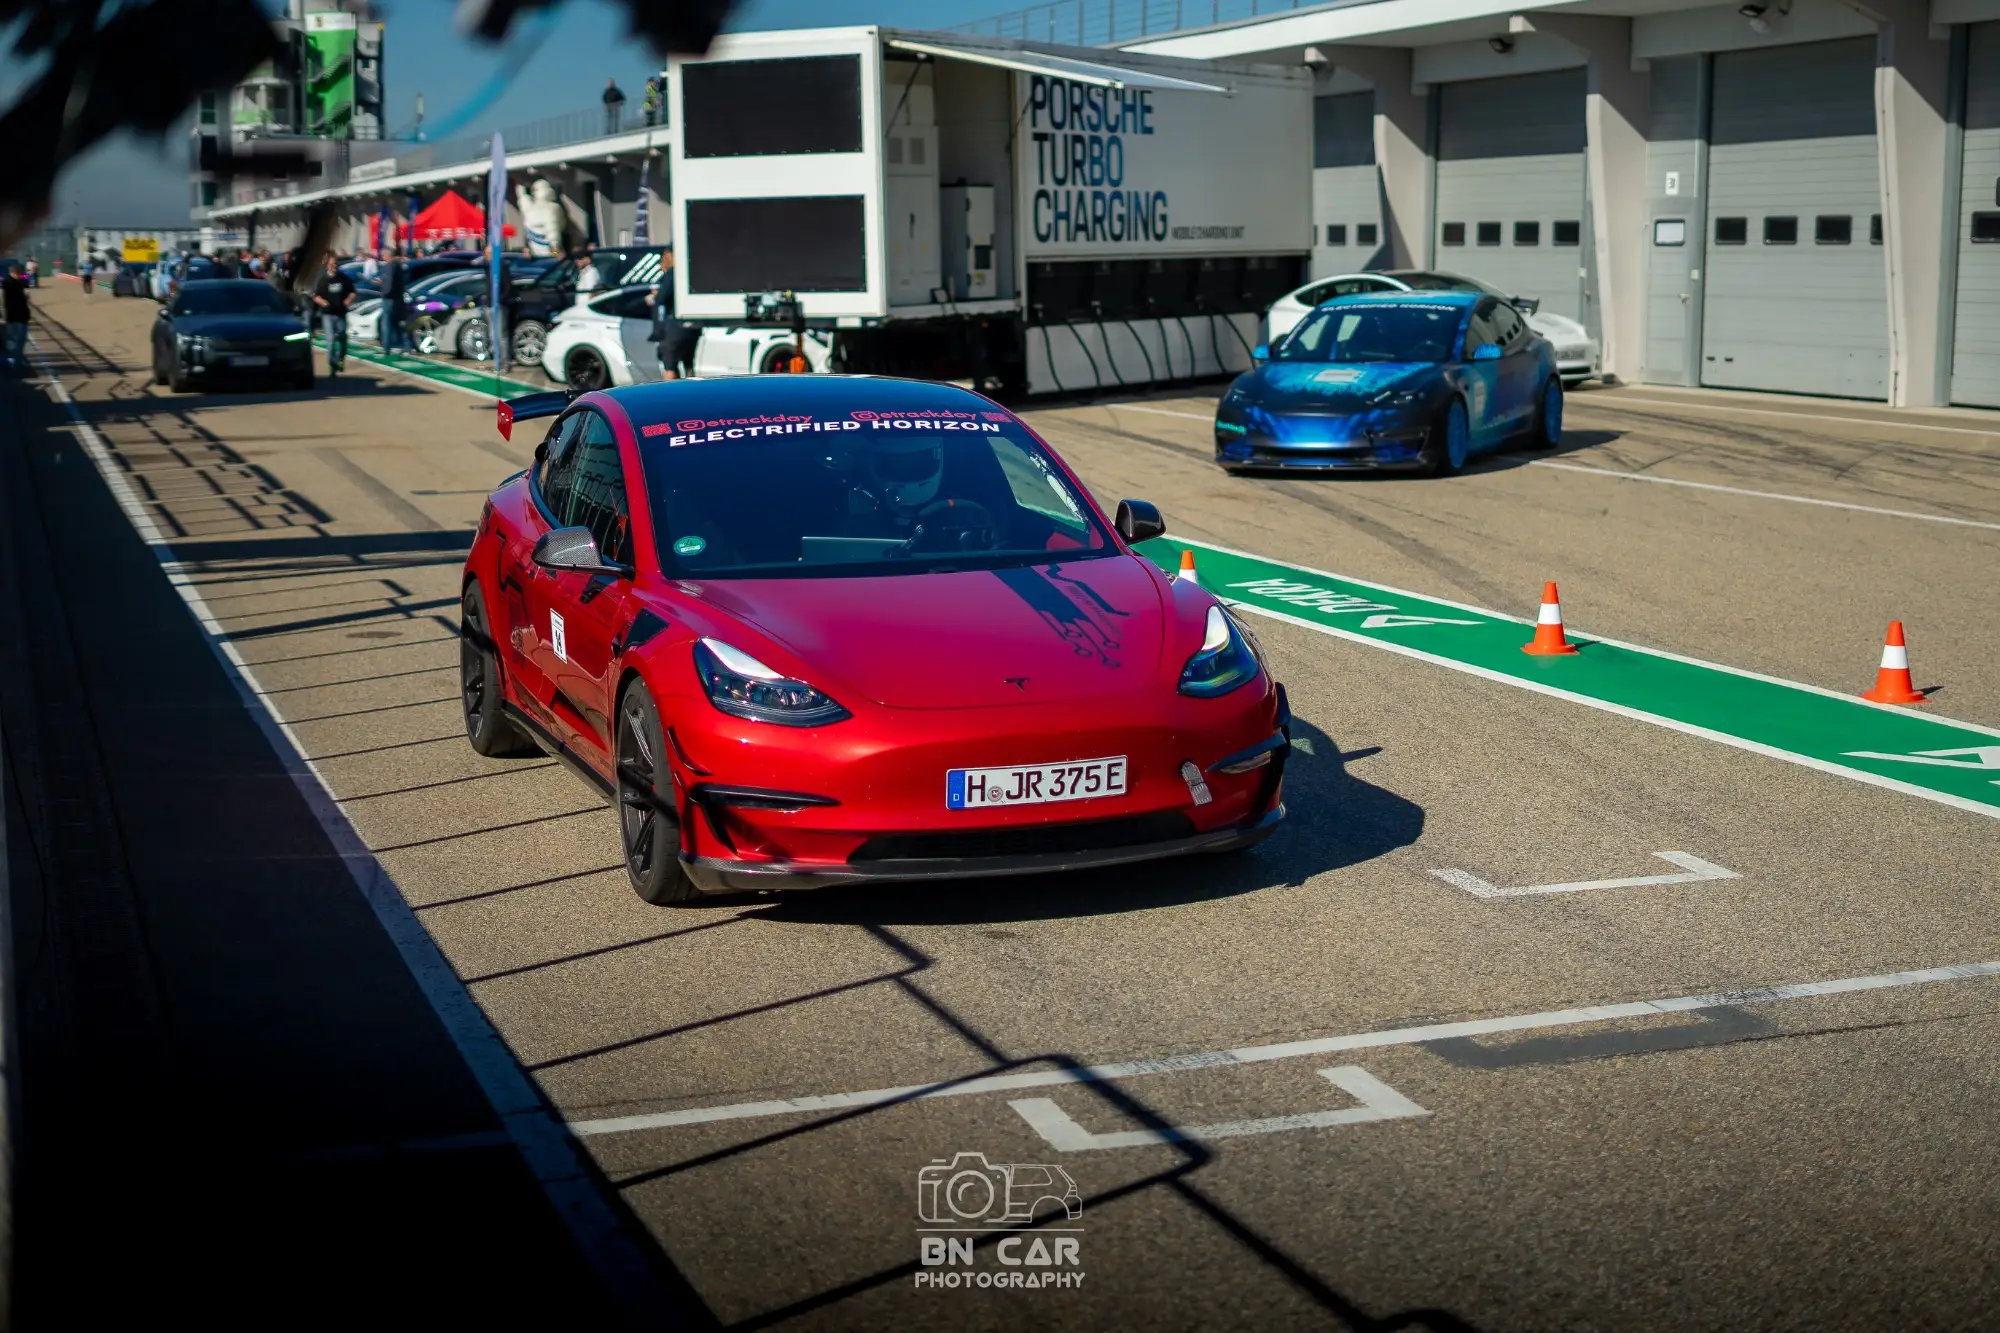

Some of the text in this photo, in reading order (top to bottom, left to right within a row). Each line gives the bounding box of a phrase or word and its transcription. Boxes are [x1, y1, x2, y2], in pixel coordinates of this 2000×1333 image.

[1030, 75, 1154, 134] PORSCHE
[1032, 132, 1123, 187] TURBO
[1033, 189, 1168, 243] CHARGING
[669, 420, 1000, 447] ELECTRIFIED HORIZON
[1225, 578, 1400, 614] DEKRA
[967, 774, 986, 803] H
